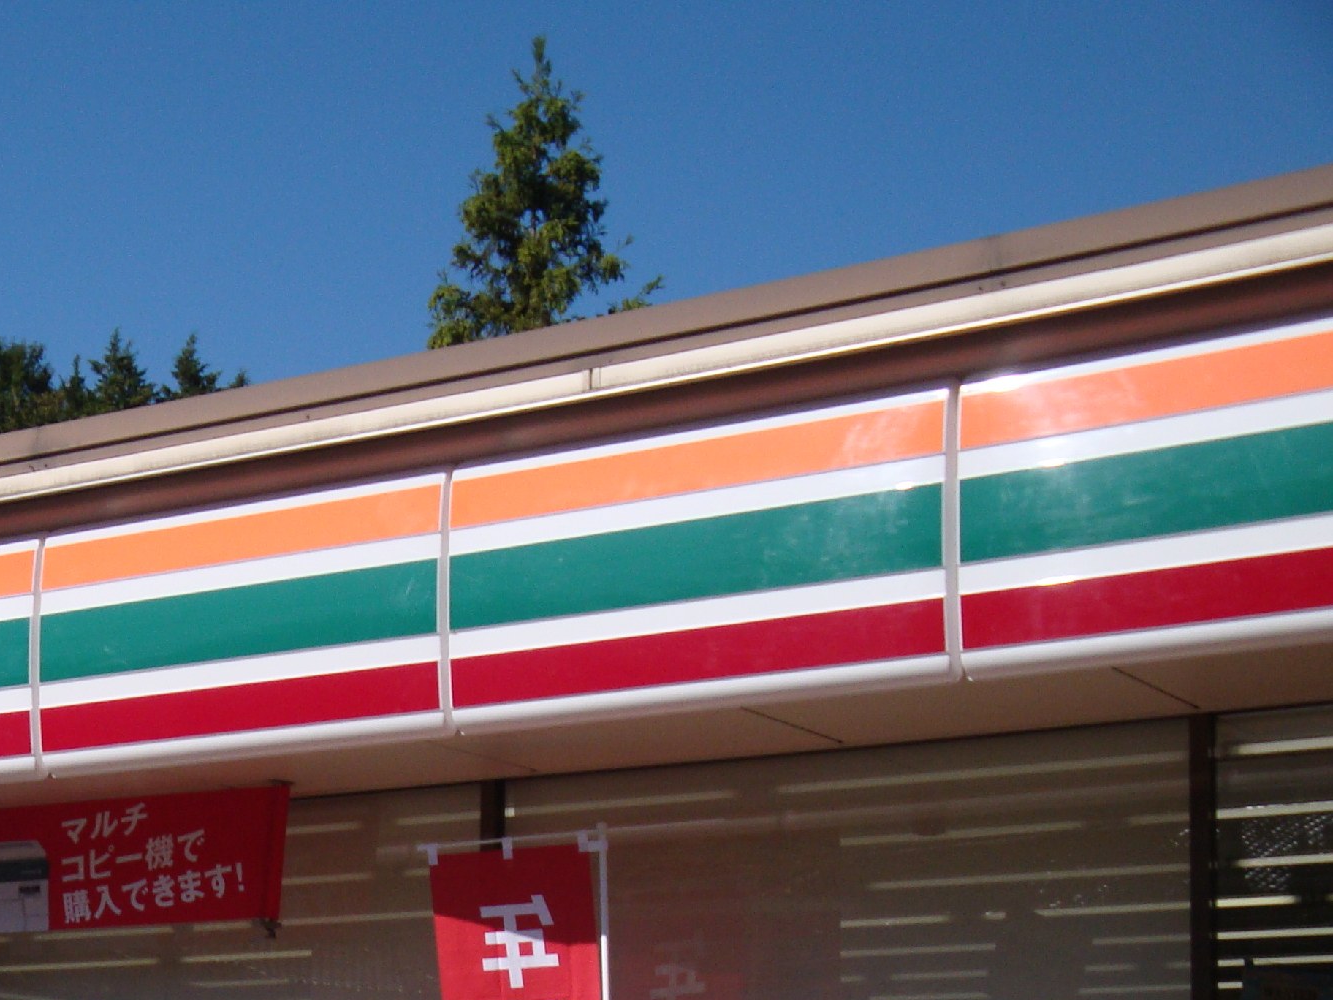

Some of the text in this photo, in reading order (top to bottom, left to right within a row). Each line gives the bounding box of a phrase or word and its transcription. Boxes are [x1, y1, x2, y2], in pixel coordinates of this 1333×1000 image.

[61, 802, 149, 843] マルチ
[61, 828, 206, 882] コピー機で
[62, 864, 244, 923] 購入できます!
